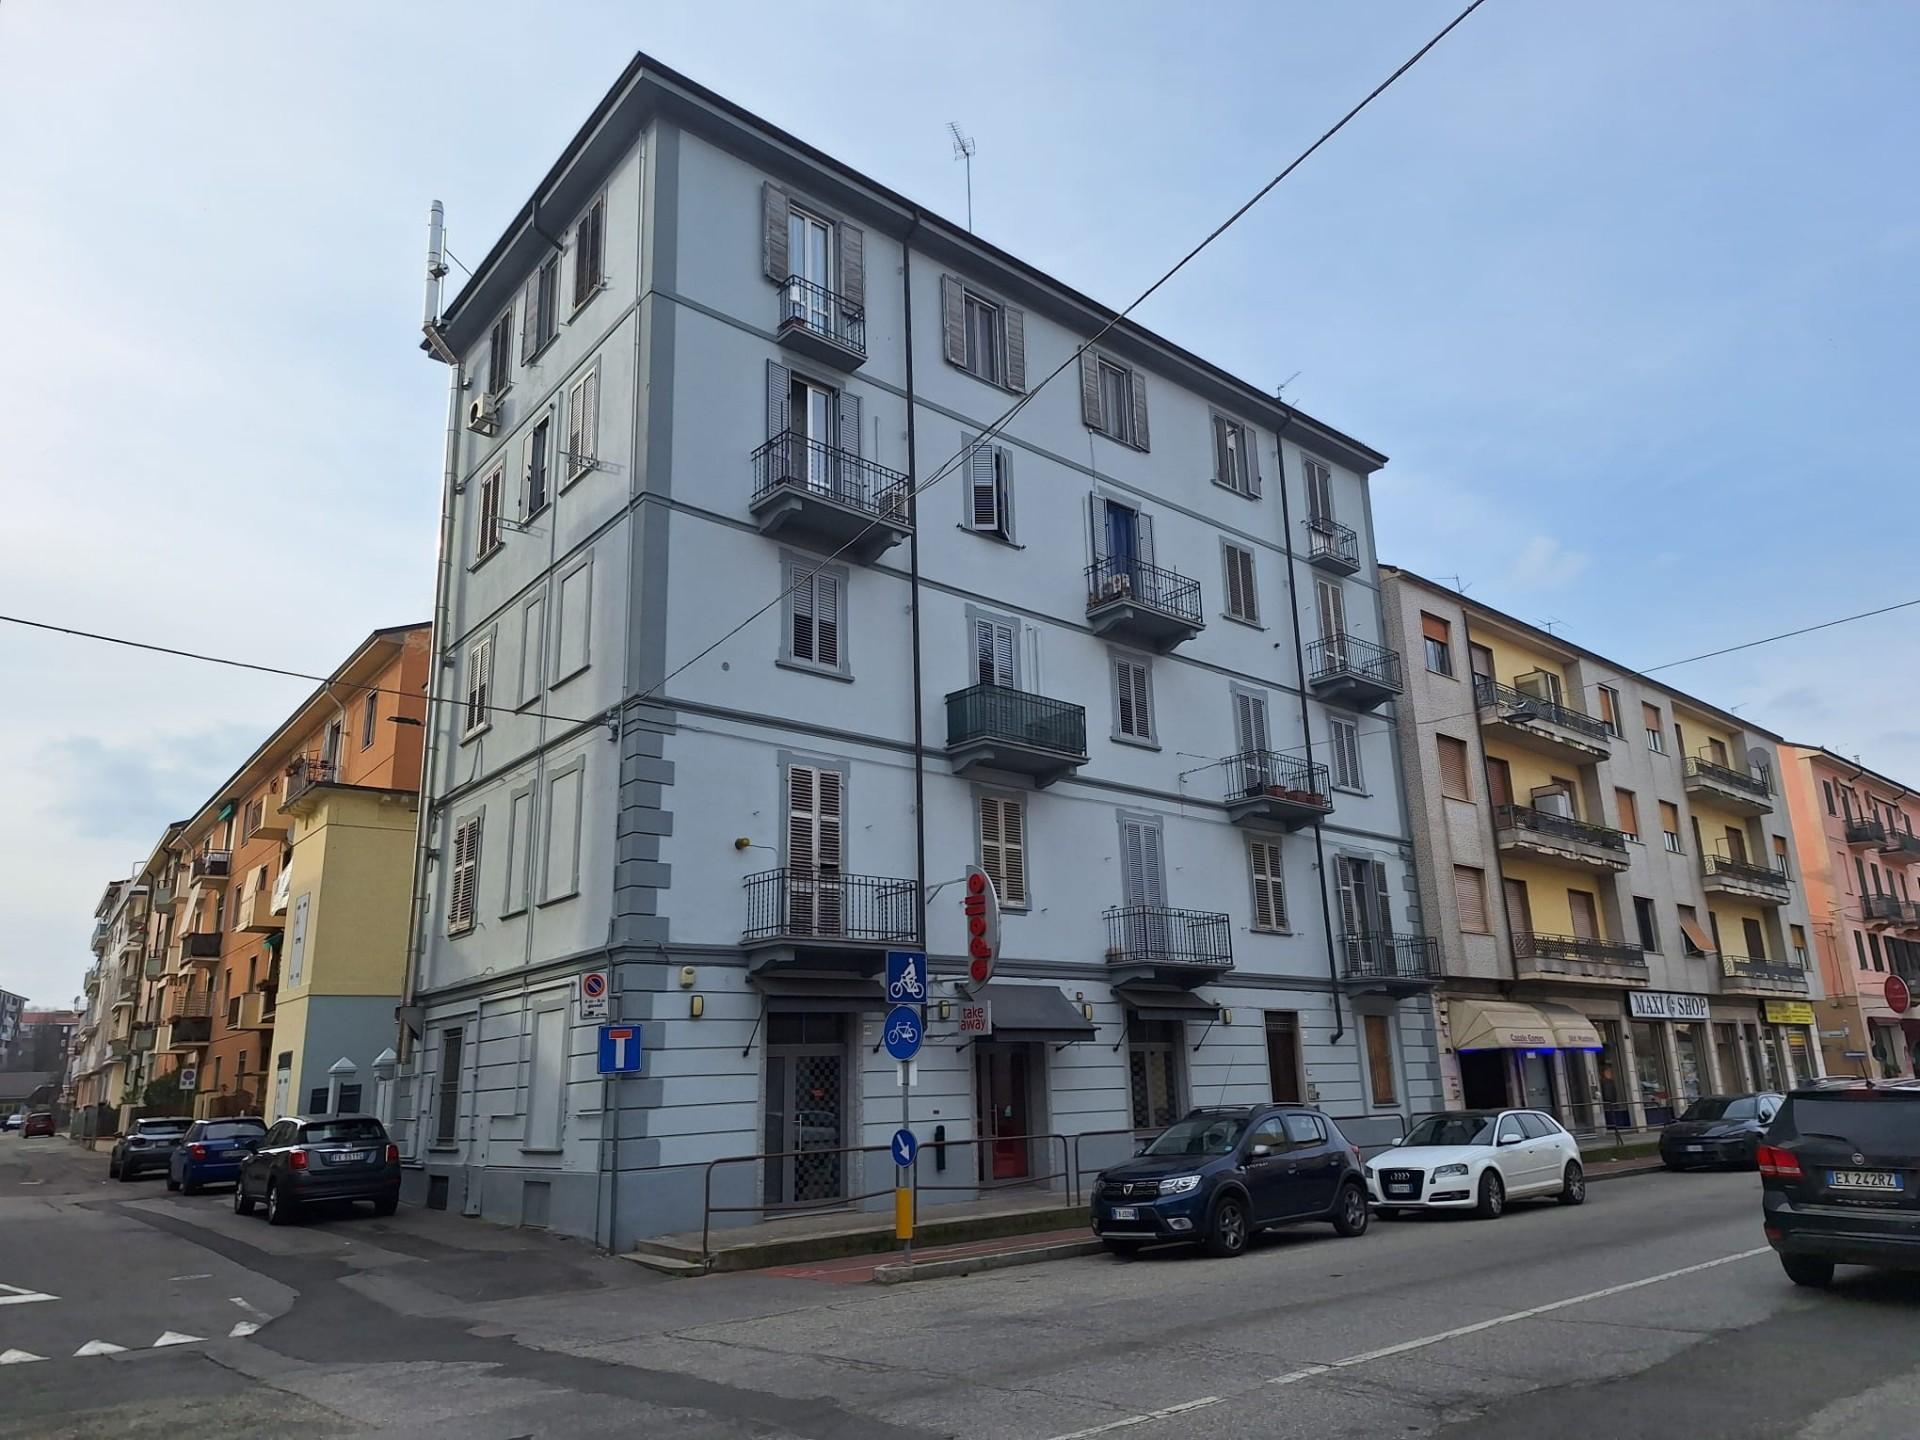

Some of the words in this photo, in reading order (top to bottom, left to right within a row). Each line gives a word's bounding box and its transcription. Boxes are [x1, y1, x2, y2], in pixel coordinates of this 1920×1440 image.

[963, 1005, 983, 1019] take
[1633, 994, 1665, 1015] MAXI
[1677, 996, 1706, 1016] SHOP
[961, 1019, 986, 1031] away
[1835, 1172, 1851, 1185] EX
[1854, 1172, 1894, 1187] 242RZ
